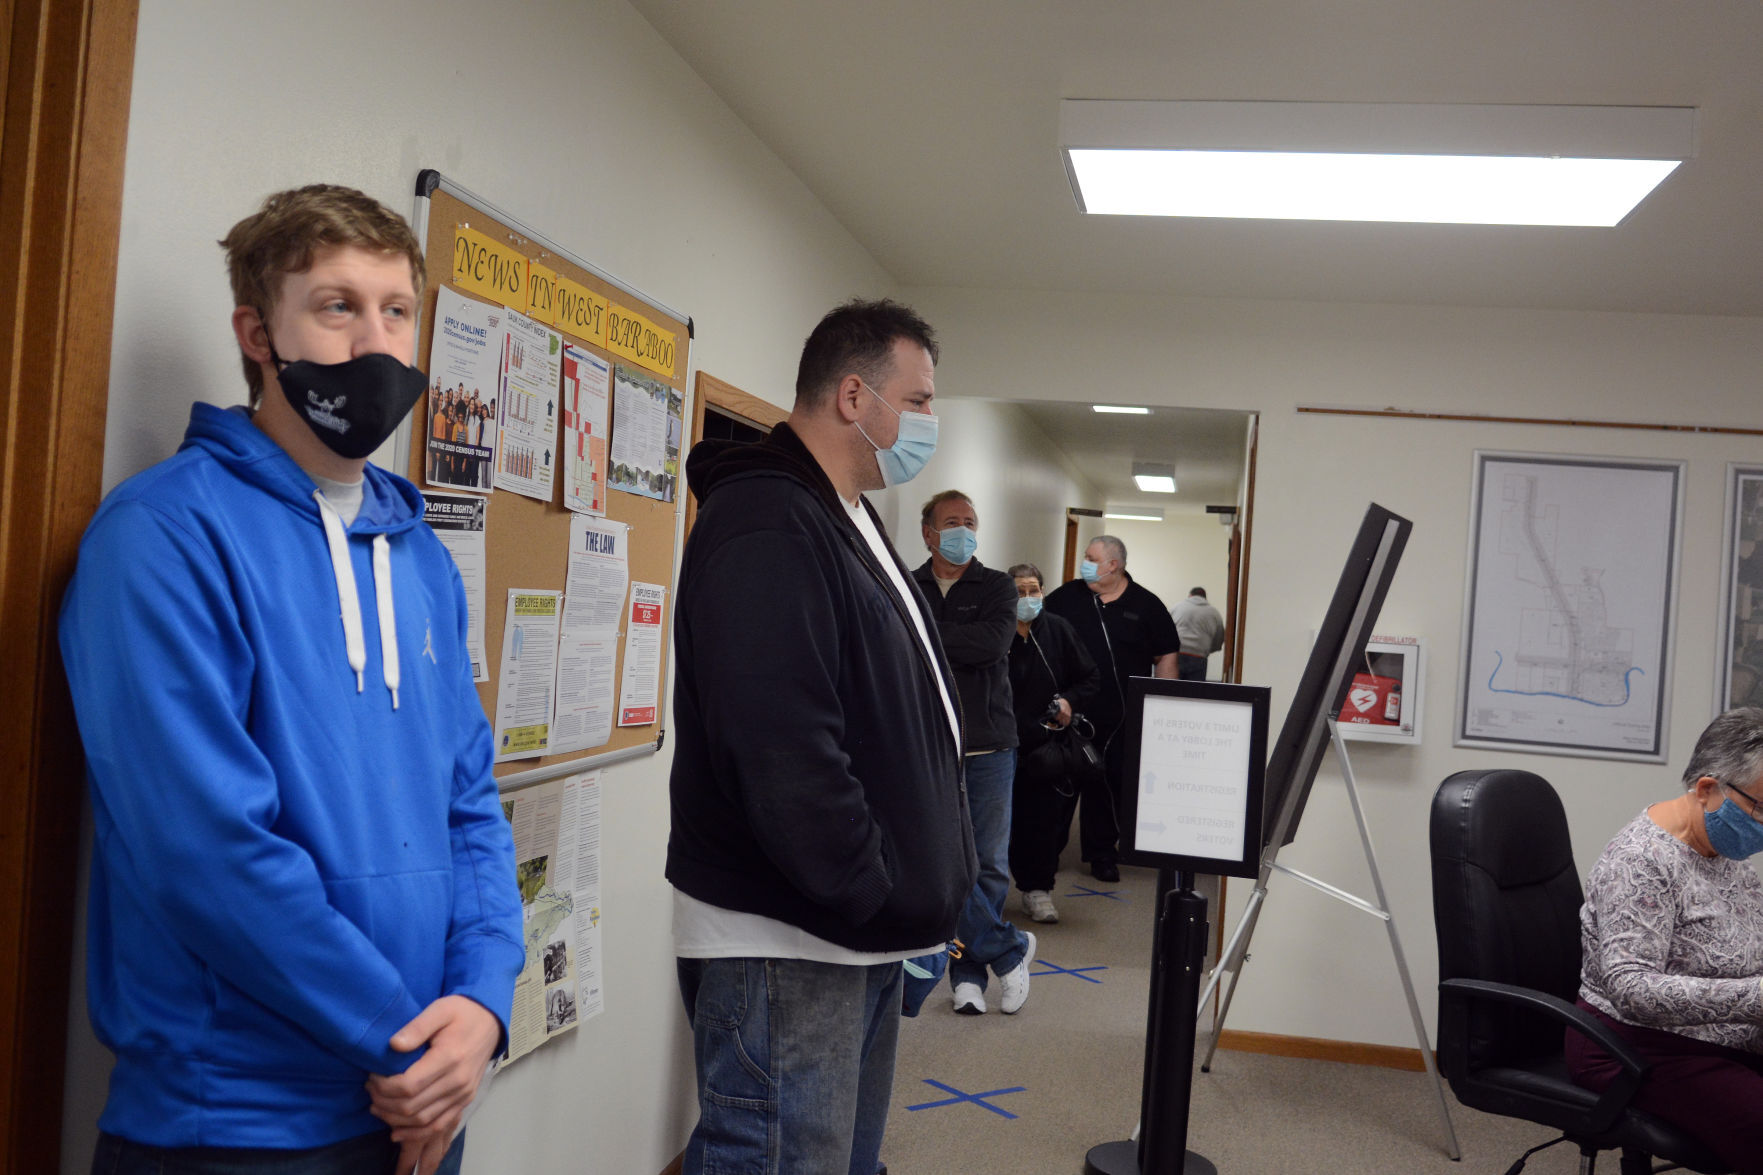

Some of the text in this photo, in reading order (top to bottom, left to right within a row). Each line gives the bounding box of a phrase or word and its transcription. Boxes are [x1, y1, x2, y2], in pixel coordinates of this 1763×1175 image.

[456, 236, 674, 369] NEWS IN WEST BARABOO
[445, 316, 487, 338] APPLY ONLINE!
[518, 317, 533, 332] COUNTY
[534, 327, 547, 339] INDEX
[445, 444, 455, 452] 2020
[456, 446, 474, 455] CENSUS
[475, 449, 489, 458] TEAM
[424, 502, 473, 513] PLOYEE RIGHTS
[585, 531, 616, 555] THE LAW
[515, 597, 556, 609] EMPLOYEE RIGHTS
[1371, 635, 1417, 645] DEFIBRILLATOR
[1351, 716, 1370, 724] AED
